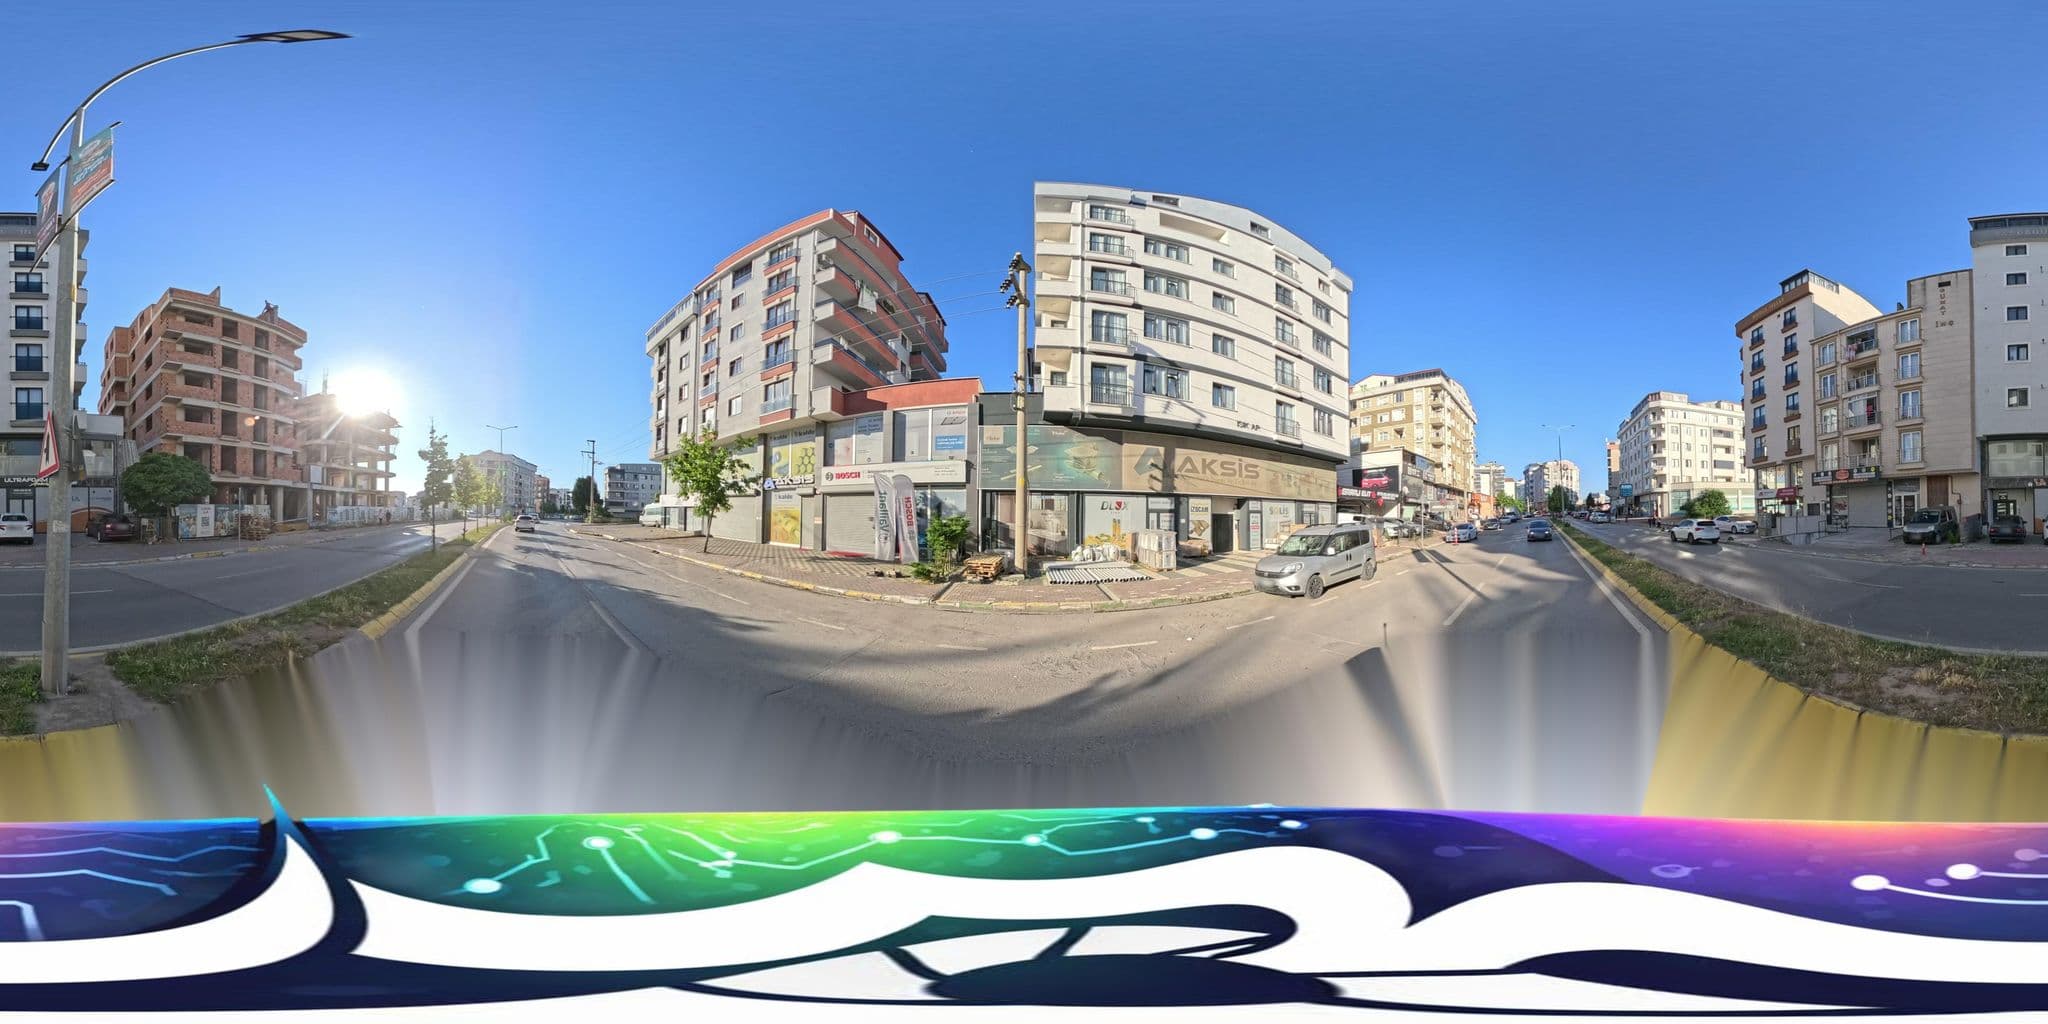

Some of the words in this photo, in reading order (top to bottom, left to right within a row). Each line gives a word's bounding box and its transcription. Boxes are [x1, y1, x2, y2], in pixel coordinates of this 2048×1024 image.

[835, 471, 861, 479] BOSCH
[879, 490, 890, 533] Vaillant
[904, 496, 914, 527] BOSCH
